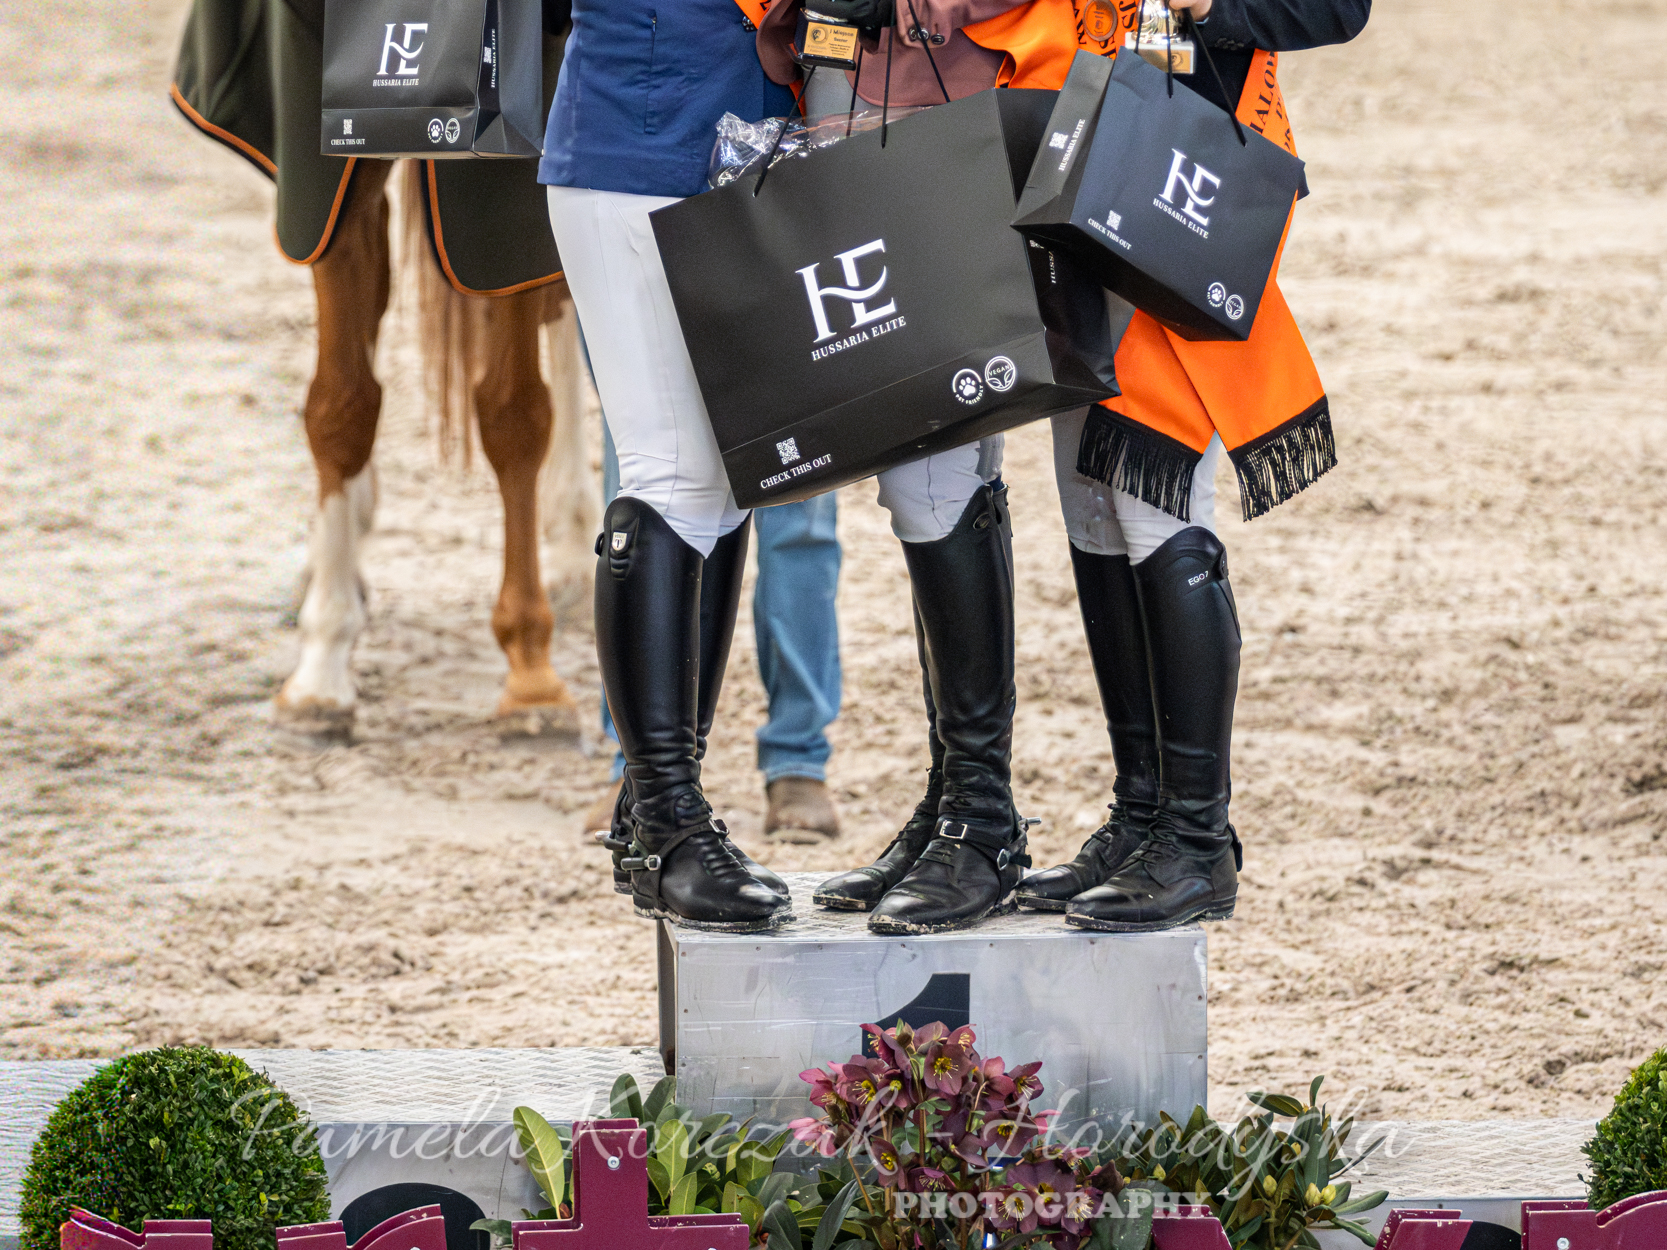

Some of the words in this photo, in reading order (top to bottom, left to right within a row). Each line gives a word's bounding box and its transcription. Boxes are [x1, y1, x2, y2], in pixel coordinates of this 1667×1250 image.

[372, 79, 401, 87] HUSSARIA
[402, 78, 419, 86] ELITE
[330, 138, 346, 146] CHECK
[1058, 141, 1078, 172] HUSSARIA
[1072, 118, 1086, 142] ELITE
[1087, 217, 1107, 235] CHECK
[1106, 228, 1120, 243] THIS
[1118, 238, 1133, 251] OUT
[1152, 197, 1187, 226] HUSSARIA
[1187, 220, 1210, 240] ELITE
[810, 331, 870, 362] HUSSARIA
[871, 315, 907, 338] ELITE
[988, 364, 1011, 376] VEGAN
[955, 393, 966, 403] PET
[965, 385, 984, 405] FRIENDLY
[760, 470, 790, 490] CHECK
[790, 462, 812, 480] THIS
[812, 453, 832, 470] OUT
